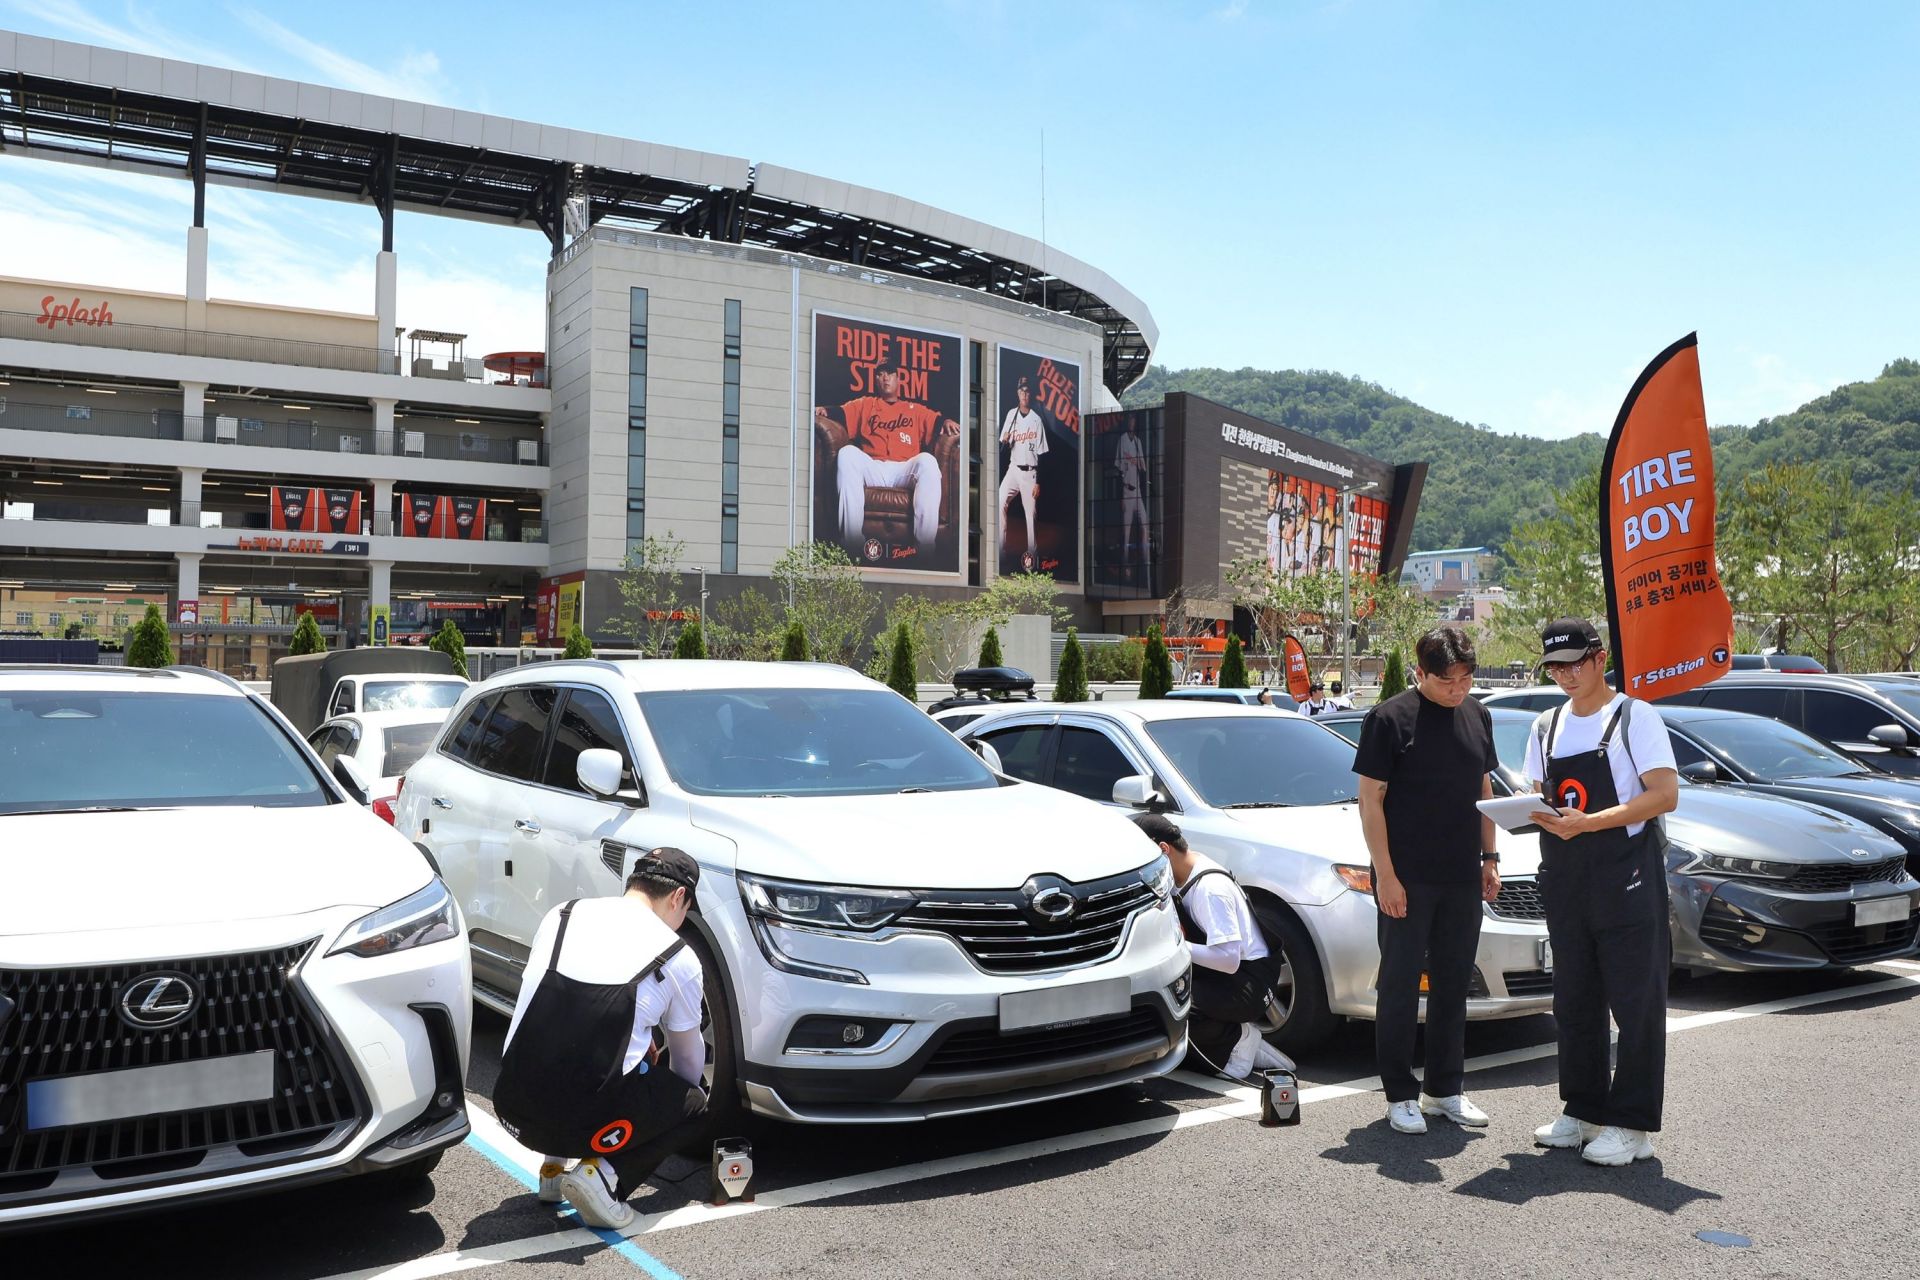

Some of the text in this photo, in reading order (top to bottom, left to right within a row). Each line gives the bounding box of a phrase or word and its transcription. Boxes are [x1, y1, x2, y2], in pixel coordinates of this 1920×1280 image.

[36, 295, 113, 330] Splash
[837, 326, 941, 372] RIDE THE
[850, 361, 928, 401] STRM
[1037, 358, 1077, 400] RIDE
[869, 413, 914, 434] Eagles
[1221, 422, 1238, 444] 대전
[899, 431, 912, 445] 99
[1028, 442, 1035, 452] 22
[1618, 448, 1696, 505] TIRE
[1623, 498, 1695, 552] BOY
[288, 538, 324, 554] GATE
[1627, 559, 1708, 593] 타이어 공기압
[1625, 577, 1718, 615] 무료 충전 서비스
[1554, 634, 1570, 643] BOY
[500, 1117, 521, 1135] TIRE
[602, 1129, 621, 1146] T
